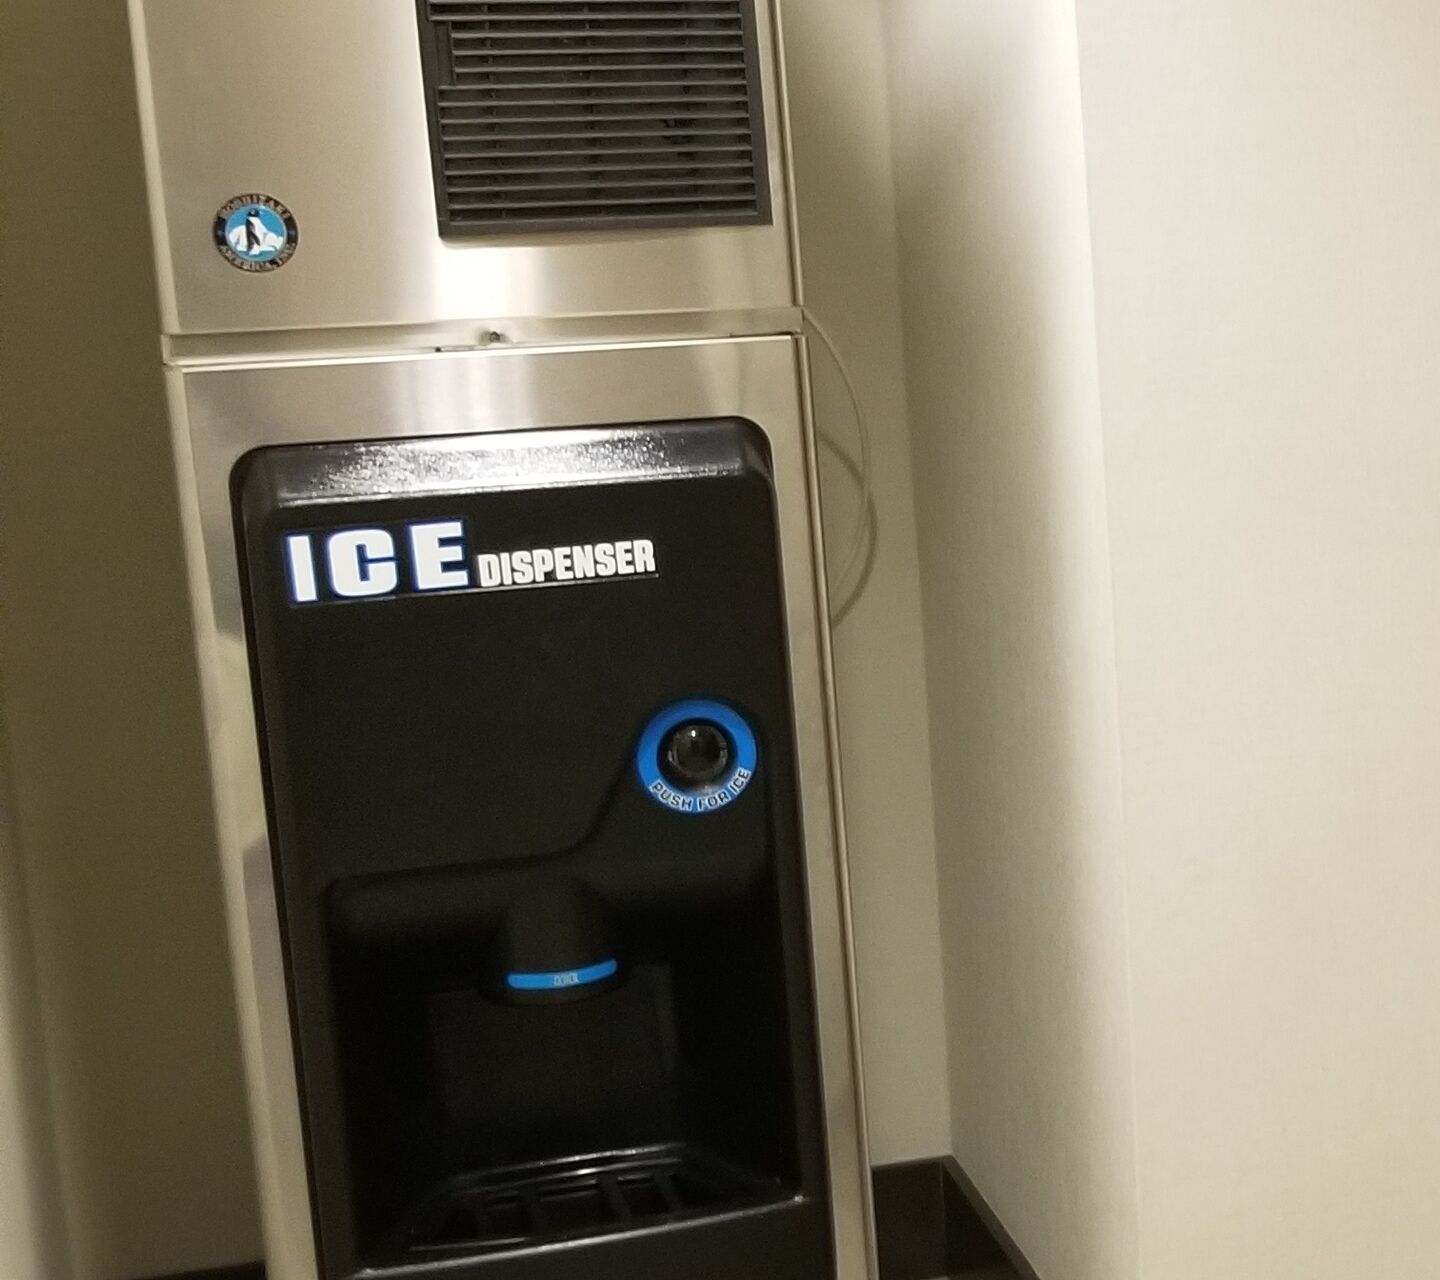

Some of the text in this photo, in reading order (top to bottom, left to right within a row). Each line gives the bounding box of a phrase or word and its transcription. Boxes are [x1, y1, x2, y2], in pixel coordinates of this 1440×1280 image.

[285, 520, 657, 603] ICE DISPENSER
[650, 766, 753, 812] PUSH FOR ICE
